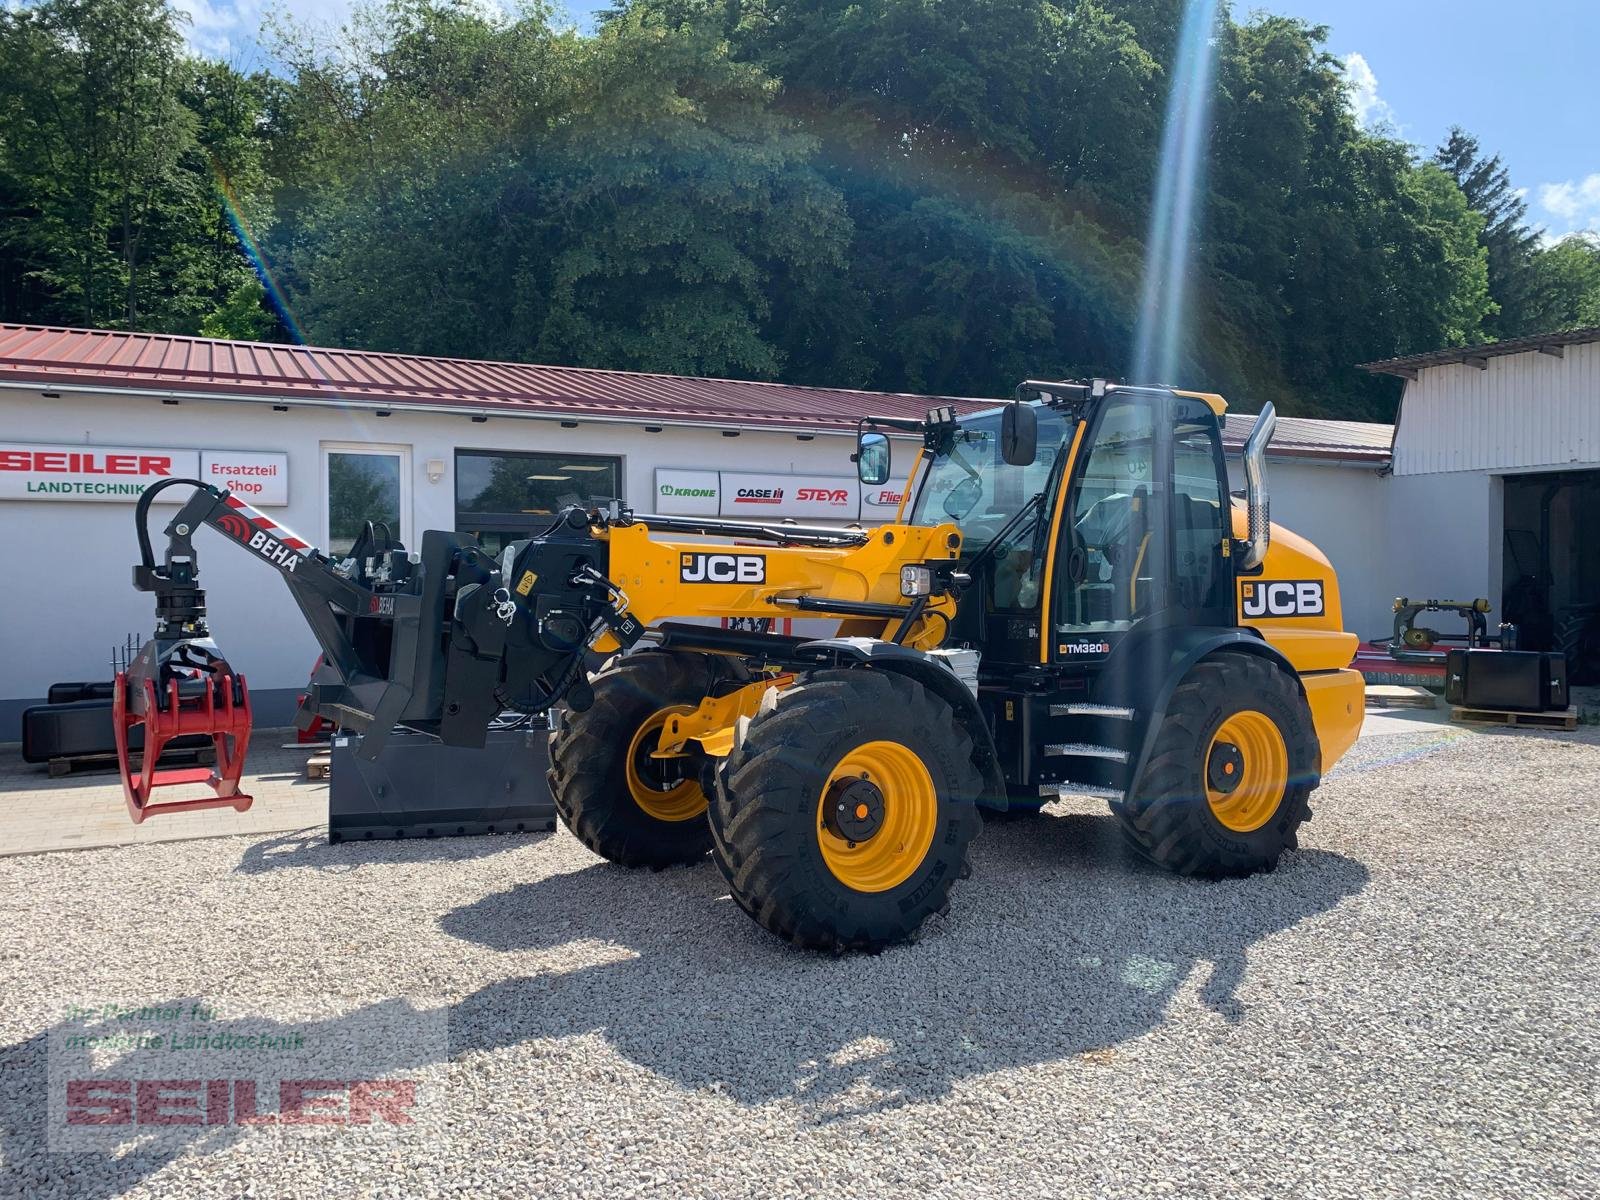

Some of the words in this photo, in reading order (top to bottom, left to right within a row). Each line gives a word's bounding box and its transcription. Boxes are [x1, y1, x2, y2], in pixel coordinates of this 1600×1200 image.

[0, 451, 171, 476] SEILER
[211, 463, 277, 476] Ersatzteil
[27, 481, 146, 495] LANDTECHNIK
[226, 480, 263, 495] Shop
[674, 487, 717, 498] KRONE
[737, 488, 771, 498] CASE
[796, 488, 849, 501] STEYR
[248, 530, 299, 573] BEHA
[682, 555, 764, 582] JCB
[1243, 582, 1323, 616] JCB
